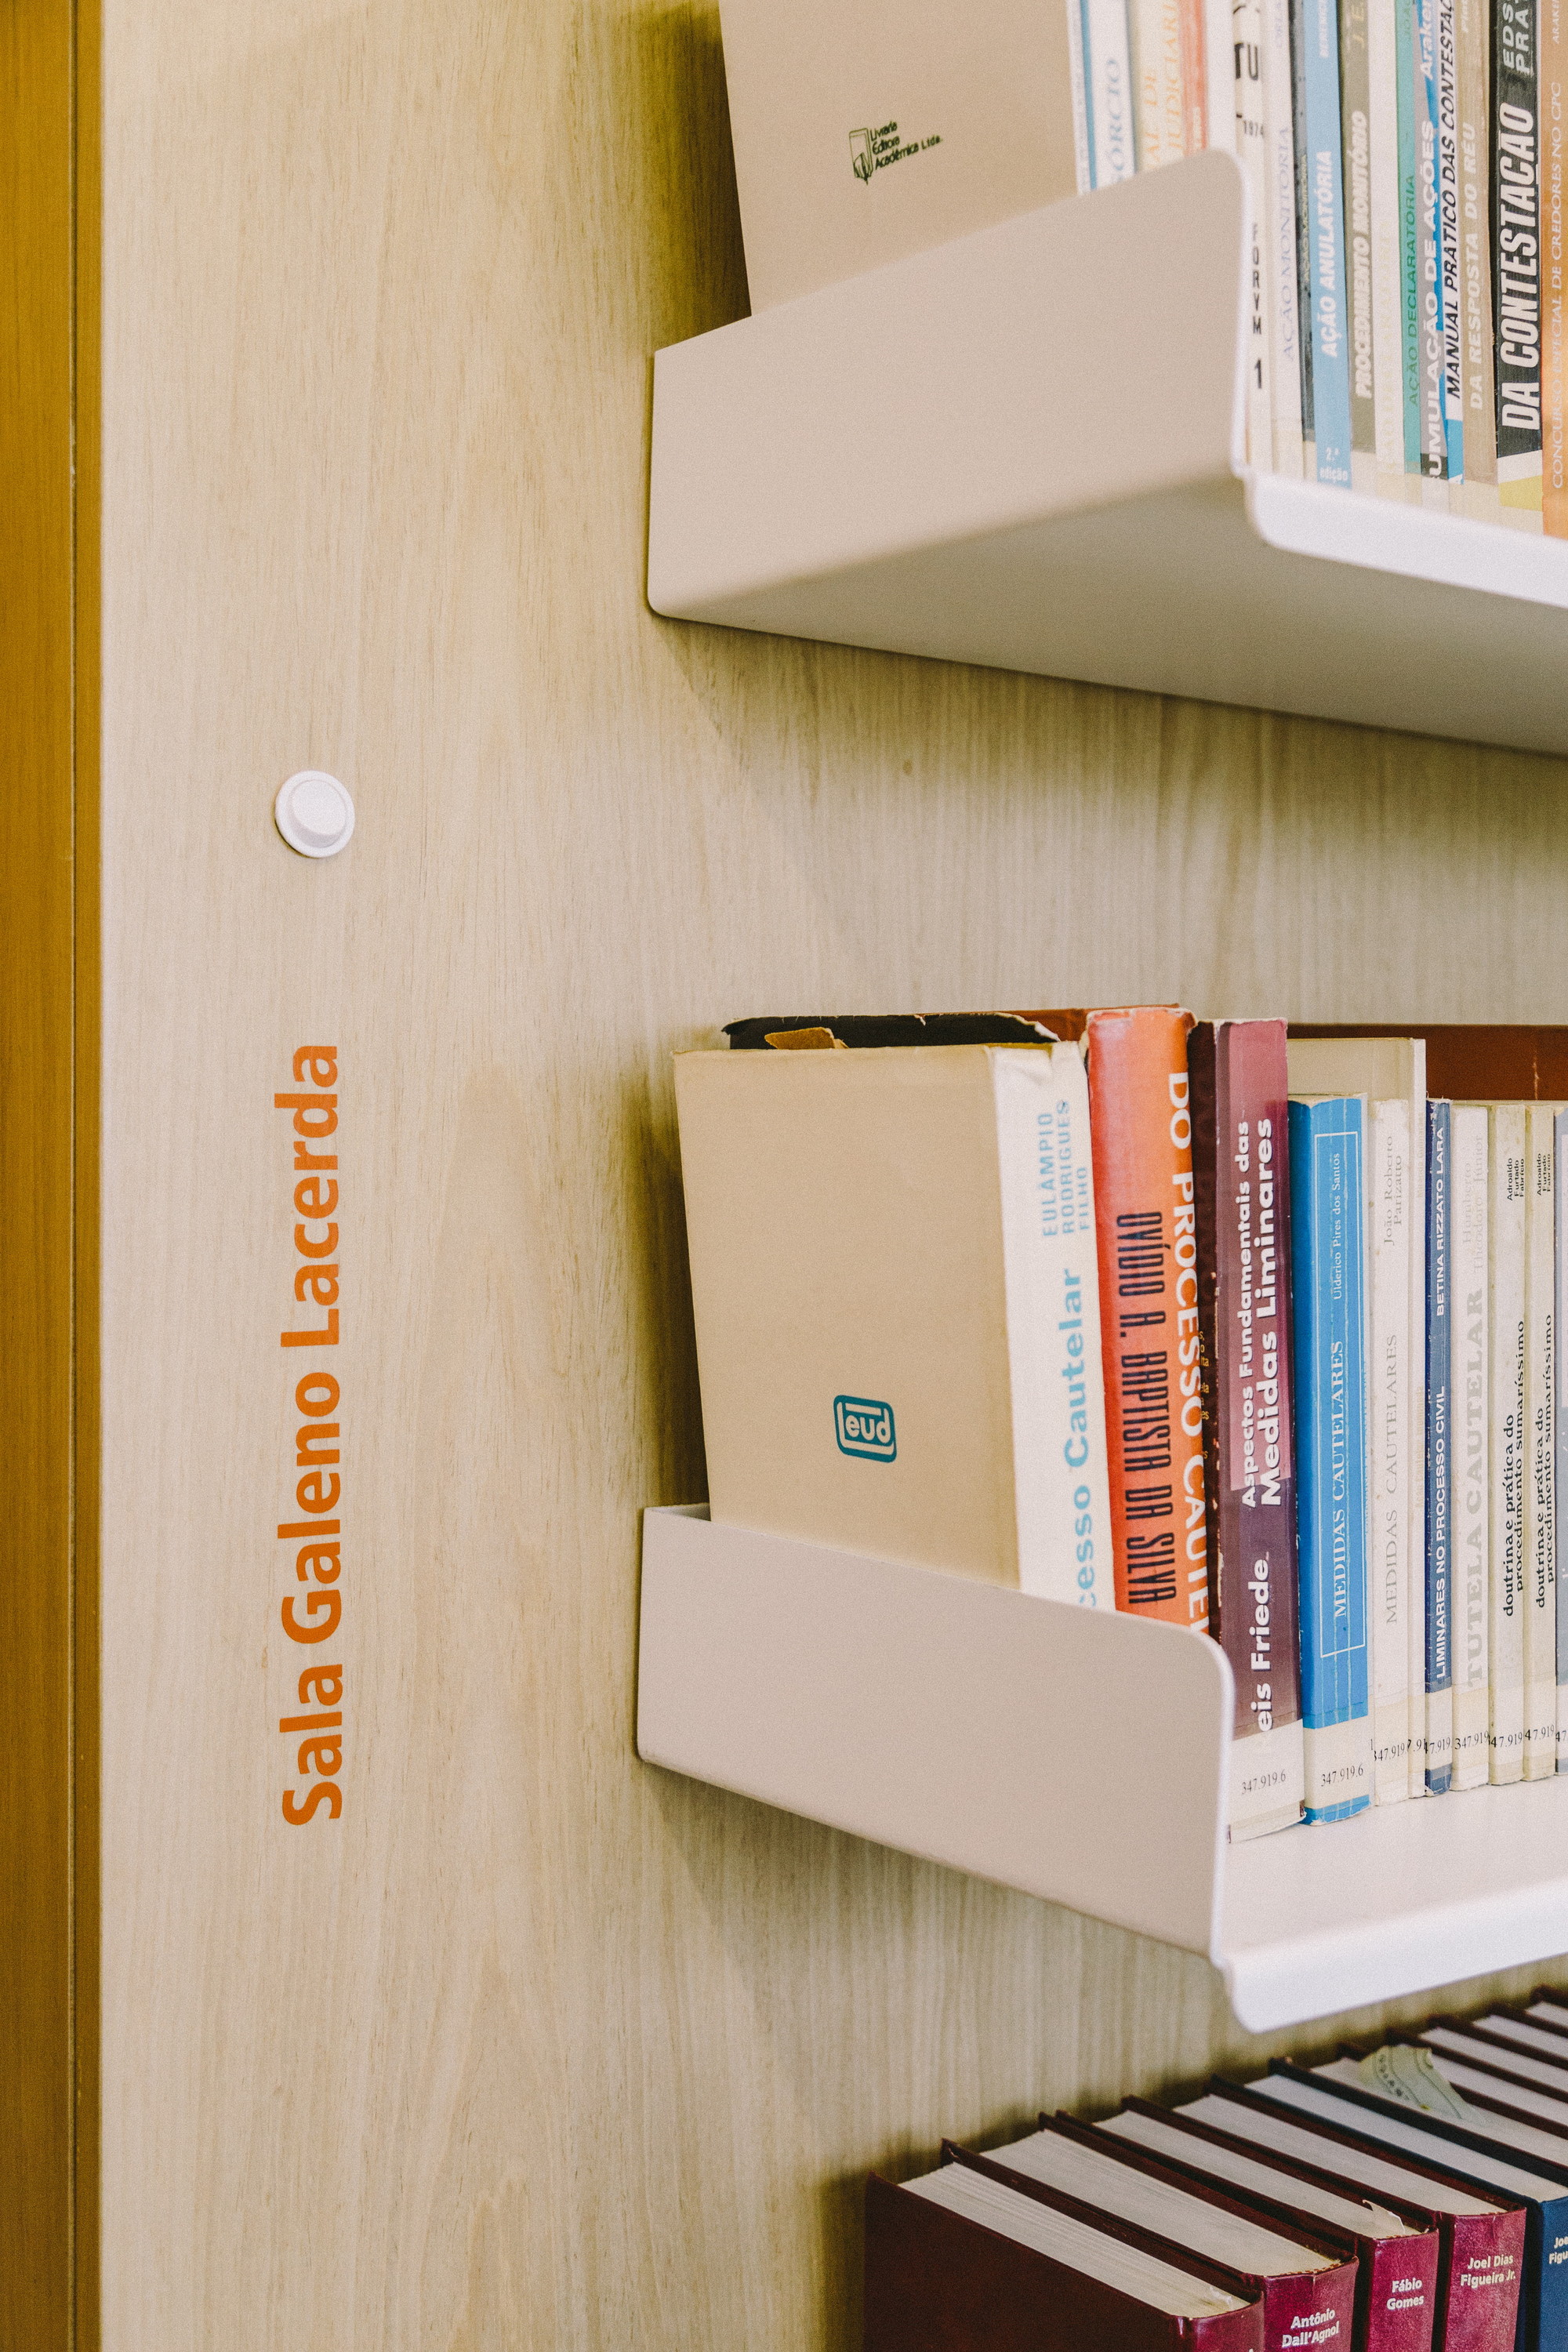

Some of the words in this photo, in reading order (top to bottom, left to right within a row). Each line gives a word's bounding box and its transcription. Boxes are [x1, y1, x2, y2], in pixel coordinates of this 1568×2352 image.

[1550, 82, 1562, 121] CPC
[872, 136, 900, 155] Editora
[875, 142, 919, 170] Acadêmica
[1347, 111, 1369, 235] MONITÓRIO
[1420, 120, 1439, 232] AÇÕES
[1441, 136, 1457, 185] DAS
[1460, 122, 1477, 172] RÉU
[1551, 128, 1562, 161] NO
[1315, 151, 1335, 291] ANULATÓRIA
[1464, 184, 1478, 220] DO
[1498, 102, 1540, 369] CONTESTAÇÃO
[1550, 164, 1563, 260] CREDORES
[1425, 239, 1439, 282] DE
[1551, 266, 1562, 291] DE
[1280, 285, 1294, 362] AÇÃO
[1316, 295, 1338, 358] AÇÃO
[1353, 236, 1372, 399] PROCEDIMENTO
[1465, 233, 1483, 364] RESPOSTA
[1254, 358, 1262, 390] 1
[1444, 299, 1461, 399] MANUAL
[1550, 301, 1562, 376] ESPECIAL
[1408, 346, 1419, 408] AÇÃO
[1424, 292, 1443, 480] UMULAÇÃO
[1470, 375, 1483, 411] DA
[1501, 381, 1541, 430] DA
[1319, 466, 1349, 485] edição
[1552, 390, 1563, 490] CONCURSO
[1168, 1072, 1192, 1150] DO
[1234, 1120, 1250, 1173] das
[1037, 1112, 1058, 1237] EULAMPIO
[1056, 1099, 1075, 1234] RODRIGUES
[1331, 1152, 1341, 1191] Santos
[1382, 1135, 1393, 1200] Roberto
[1436, 1127, 1445, 1174] LARA
[274, 1046, 339, 1347] Lacerda
[1076, 1167, 1090, 1230] FILHO
[1254, 1117, 1276, 1319] Liminares
[1331, 1199, 1341, 1215] dos
[1392, 1154, 1403, 1225] Parizatto
[1436, 1178, 1445, 1250] RIZZATO
[1116, 1211, 1171, 1298] OVÍDIO
[1331, 1218, 1341, 1249] Pires
[1383, 1207, 1396, 1246] João
[1171, 1171, 1203, 1438] PROCESSO
[1235, 1180, 1254, 1378] Fundamentais
[1331, 1251, 1342, 1301] Ulderico
[1436, 1254, 1445, 1316] BETINA
[1120, 1310, 1167, 1338] A.
[1058, 1269, 1090, 1468] Cautelar
[1466, 1287, 1483, 1515] CAUTELAR
[1515, 1320, 1525, 1450] sumaríssimo
[1120, 1351, 1172, 1473] BAPTISTA
[1255, 1330, 1281, 1506] Medidas
[1330, 1341, 1345, 1501] CAUTELARES
[1385, 1334, 1398, 1495] CAUTELARES
[1436, 1385, 1446, 1434] CIVIL
[1502, 1414, 1514, 1439] do
[1536, 1408, 1544, 1431] do
[1241, 1385, 1259, 1508] Aspectos
[1501, 1443, 1516, 1514] prática
[1536, 1436, 1546, 1504] prática
[278, 1372, 342, 1644] Galeno
[1124, 1484, 1174, 1521] DA
[1436, 1438, 1446, 1542] PROCESSO
[1514, 1457, 1524, 1592] procedimento
[1537, 1513, 1544, 1523] e
[1544, 1450, 1555, 1584] procedimento
[1331, 1508, 1348, 1617] MEDIDAS
[1436, 1544, 1446, 1573] NO
[1505, 1523, 1514, 1531] e
[1126, 1531, 1177, 1605] SILVA
[1385, 1509, 1398, 1625] MEDIDAS
[1503, 1533, 1514, 1617] doutrina
[1535, 1525, 1545, 1608] doutrina
[1247, 1558, 1271, 1671] Friede
[1436, 1578, 1446, 1679] LIMINARES
[1466, 1523, 1483, 1687] TUTELA
[280, 1664, 343, 1825] Sala
[1319, 1764, 1364, 1788] 347.919.6
[1241, 1769, 1287, 1795] 347.919.6
[1391, 2278, 1423, 2293] Fábio
[1460, 2270, 1504, 2289] Figueira
[1504, 2269, 1517, 2283] Jr.
[1467, 2256, 1491, 2271] Joel
[1493, 2255, 1514, 2268] Dias
[1290, 2307, 1336, 2330] Antônio
[1386, 2294, 1425, 2311] Gomes
